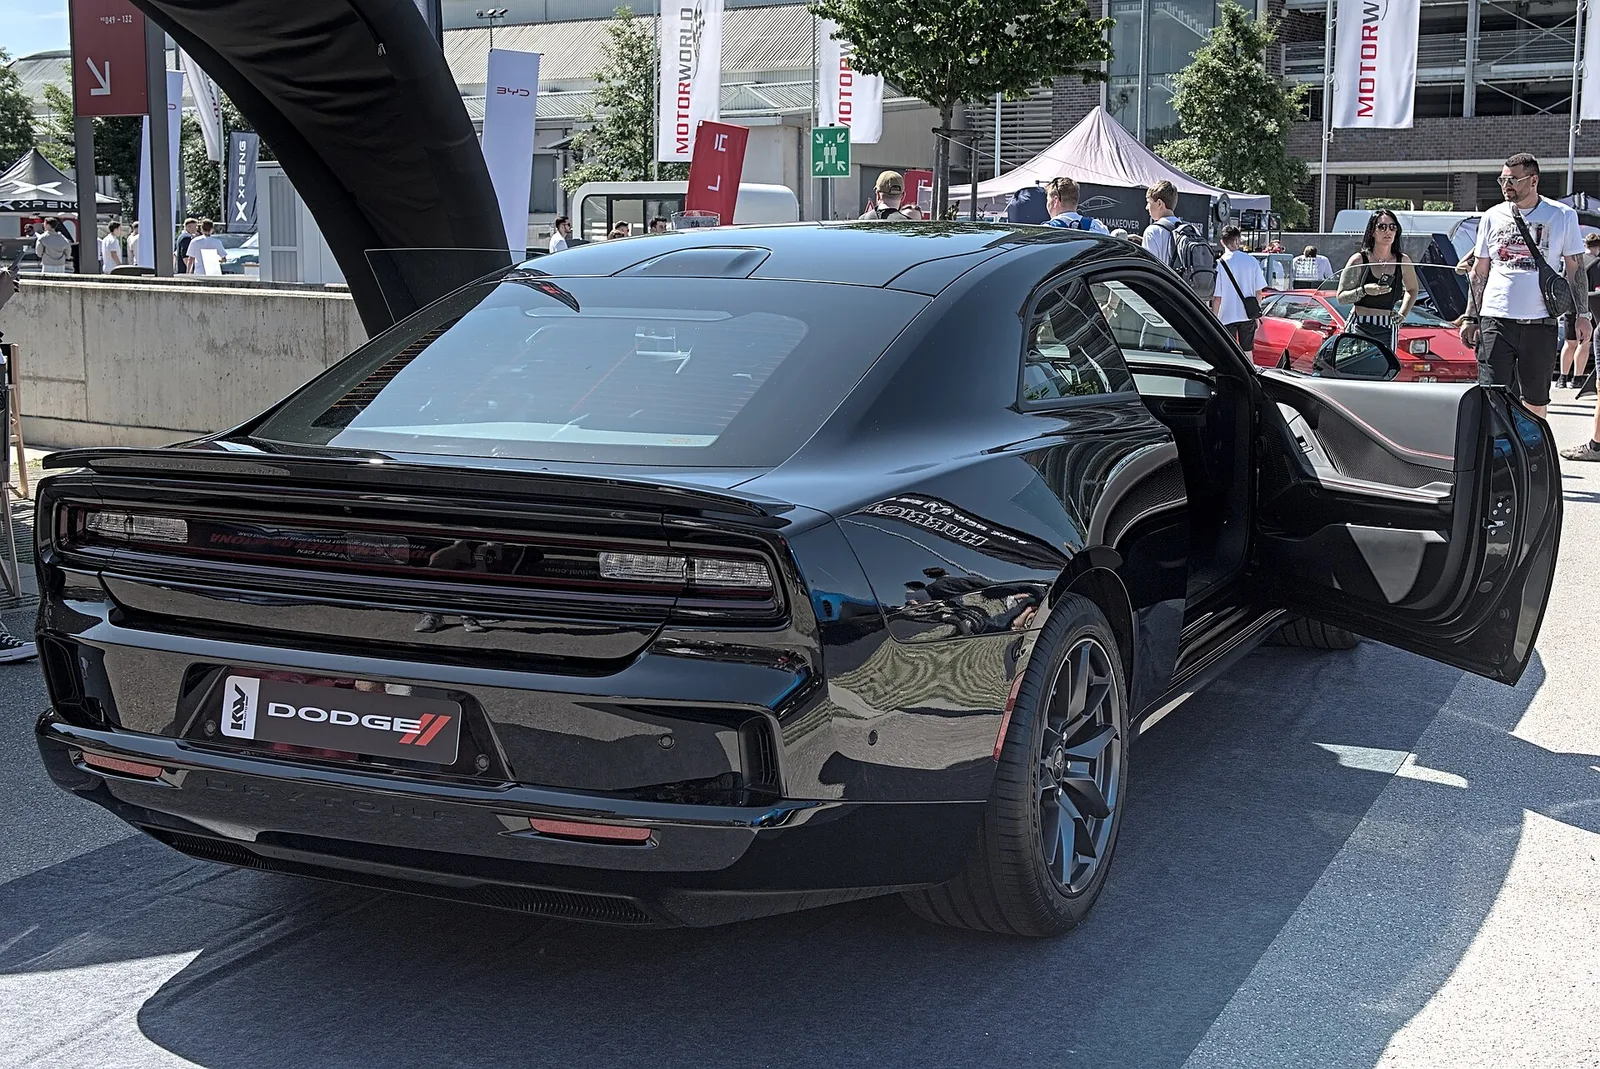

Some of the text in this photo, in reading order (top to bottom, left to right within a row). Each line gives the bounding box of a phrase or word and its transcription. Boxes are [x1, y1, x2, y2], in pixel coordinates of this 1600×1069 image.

[496, 86, 530, 97] BYD
[676, 7, 694, 154] MOTORWORLD
[237, 140, 247, 199] XPENG
[1106, 218, 1140, 230] MAKEOVER
[267, 702, 422, 735] DODGE
